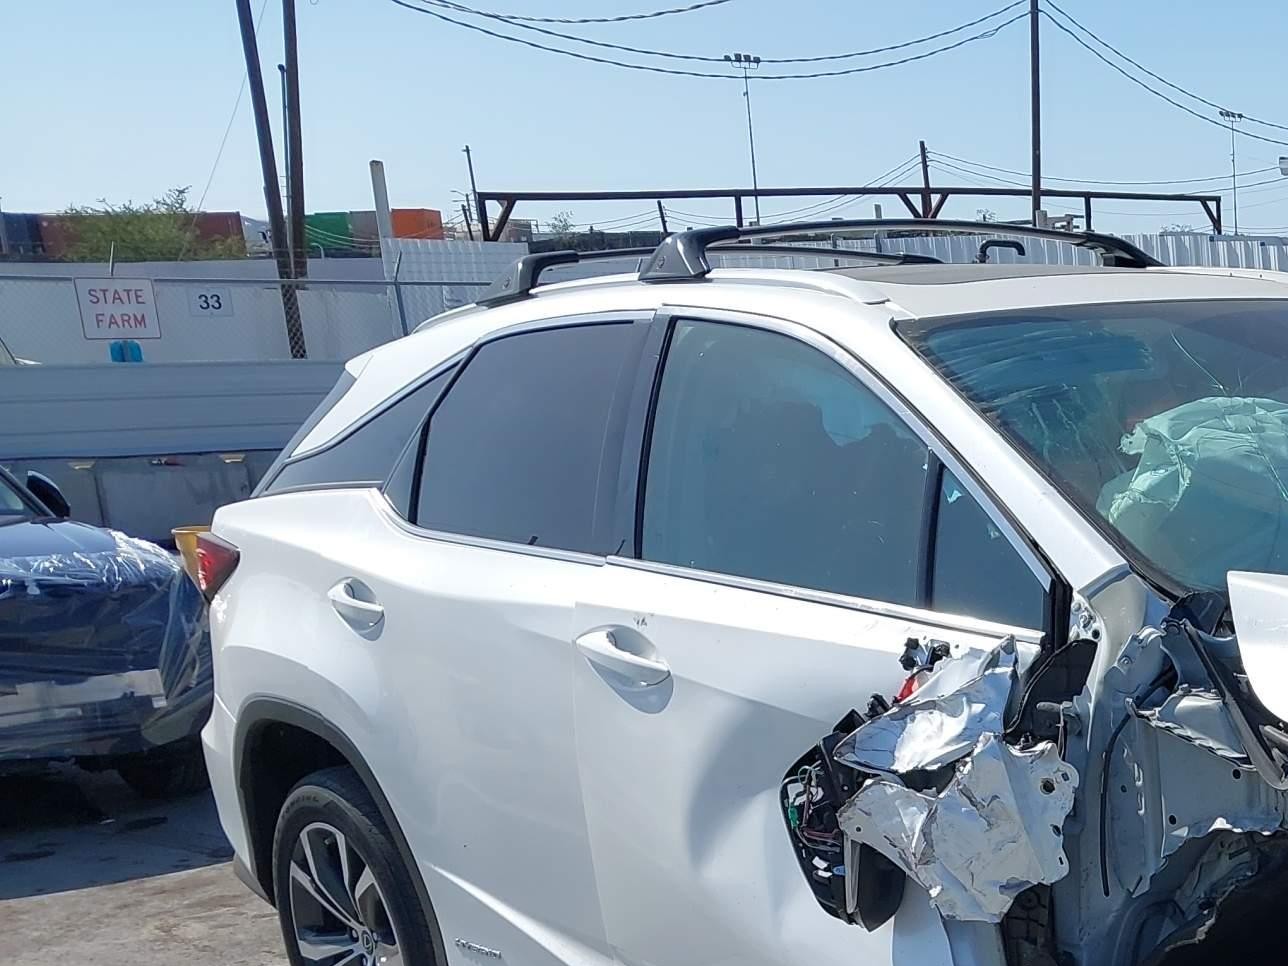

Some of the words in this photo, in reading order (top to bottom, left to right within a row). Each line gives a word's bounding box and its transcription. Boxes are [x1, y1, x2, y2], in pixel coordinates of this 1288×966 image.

[88, 289, 146, 304] STATE
[198, 294, 222, 310] 33
[95, 313, 147, 329] FARM
